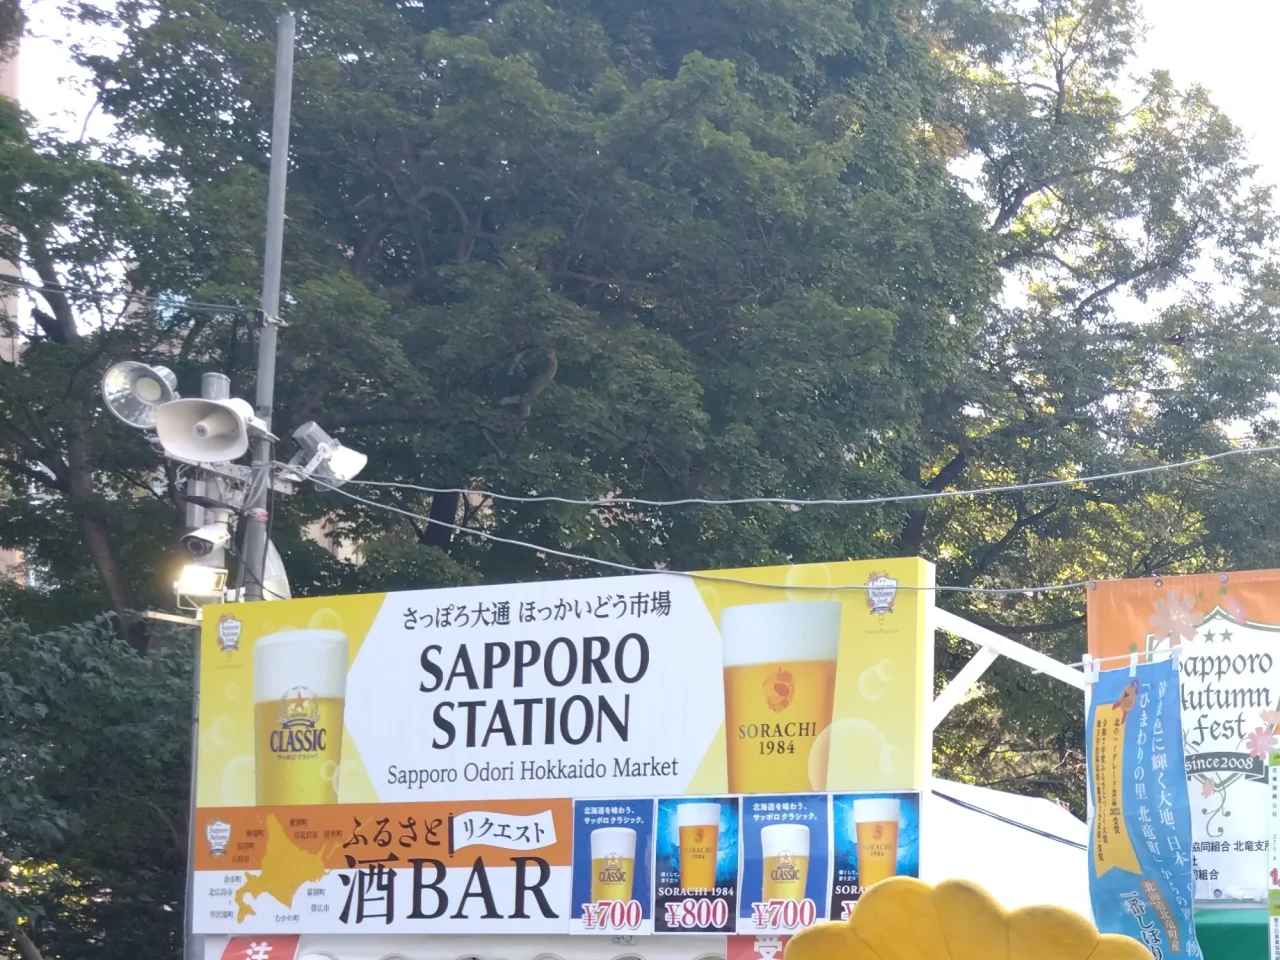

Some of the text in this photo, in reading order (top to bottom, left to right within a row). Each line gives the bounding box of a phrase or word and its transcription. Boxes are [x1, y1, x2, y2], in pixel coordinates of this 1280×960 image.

[403, 590, 672, 630] さっぽろ大通 ほっかいどう市場
[419, 632, 650, 693] SAPPORO
[431, 693, 631, 750] STATION
[738, 722, 817, 739] SORACHI
[269, 727, 327, 752] CLASSIC
[759, 740, 795, 755] 1984
[387, 756, 679, 790] Sapporo Odori Hokkaido Market
[342, 816, 443, 849] ふるさと
[463, 817, 545, 844] リクエスト
[338, 852, 560, 925] 酒BAR
[658, 886, 734, 897] SORACHI 1984
[583, 901, 642, 929] ¥700
[665, 899, 728, 928] ¥800
[752, 899, 816, 928] ¥700
